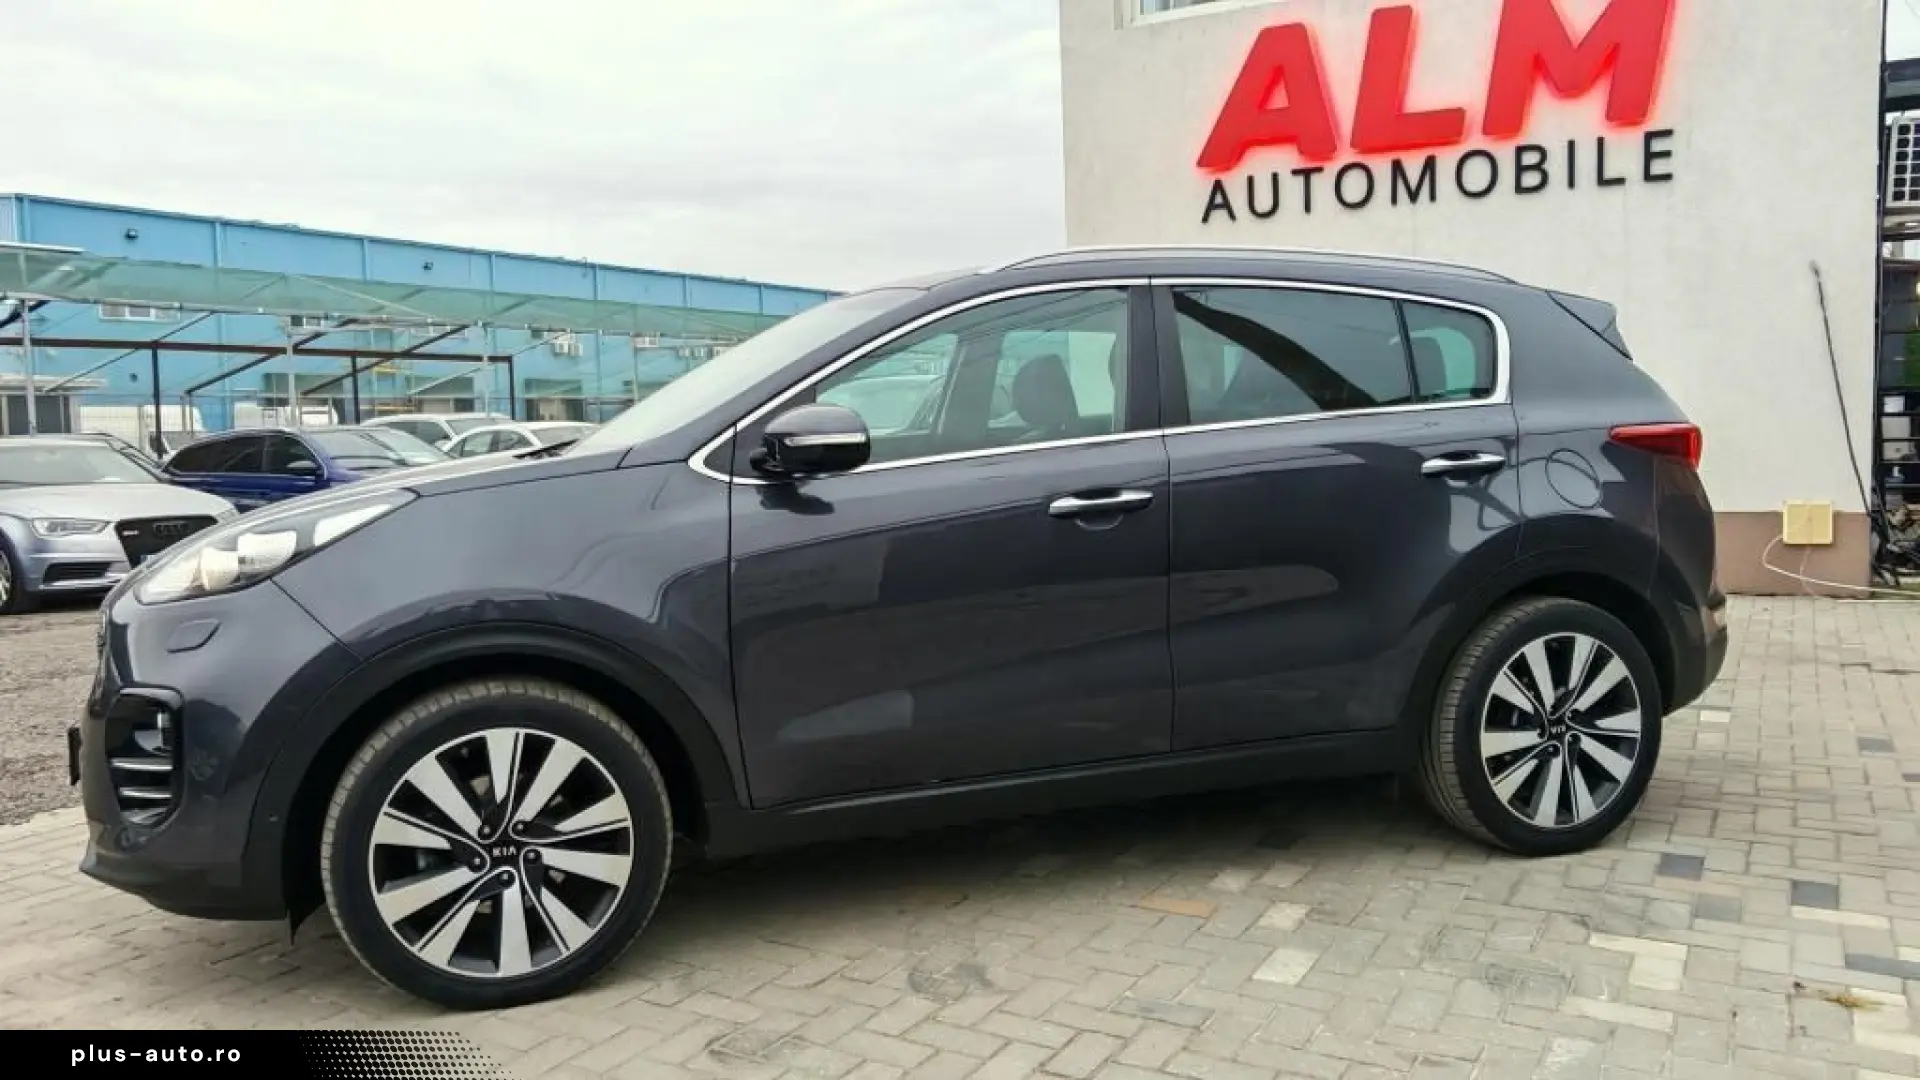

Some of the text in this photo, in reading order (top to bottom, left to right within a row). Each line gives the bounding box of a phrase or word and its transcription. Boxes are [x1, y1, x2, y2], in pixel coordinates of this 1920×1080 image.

[1197, 0, 1674, 174] ALM
[1201, 129, 1674, 224] AUTOMOBILE
[492, 845, 517, 858] KIA
